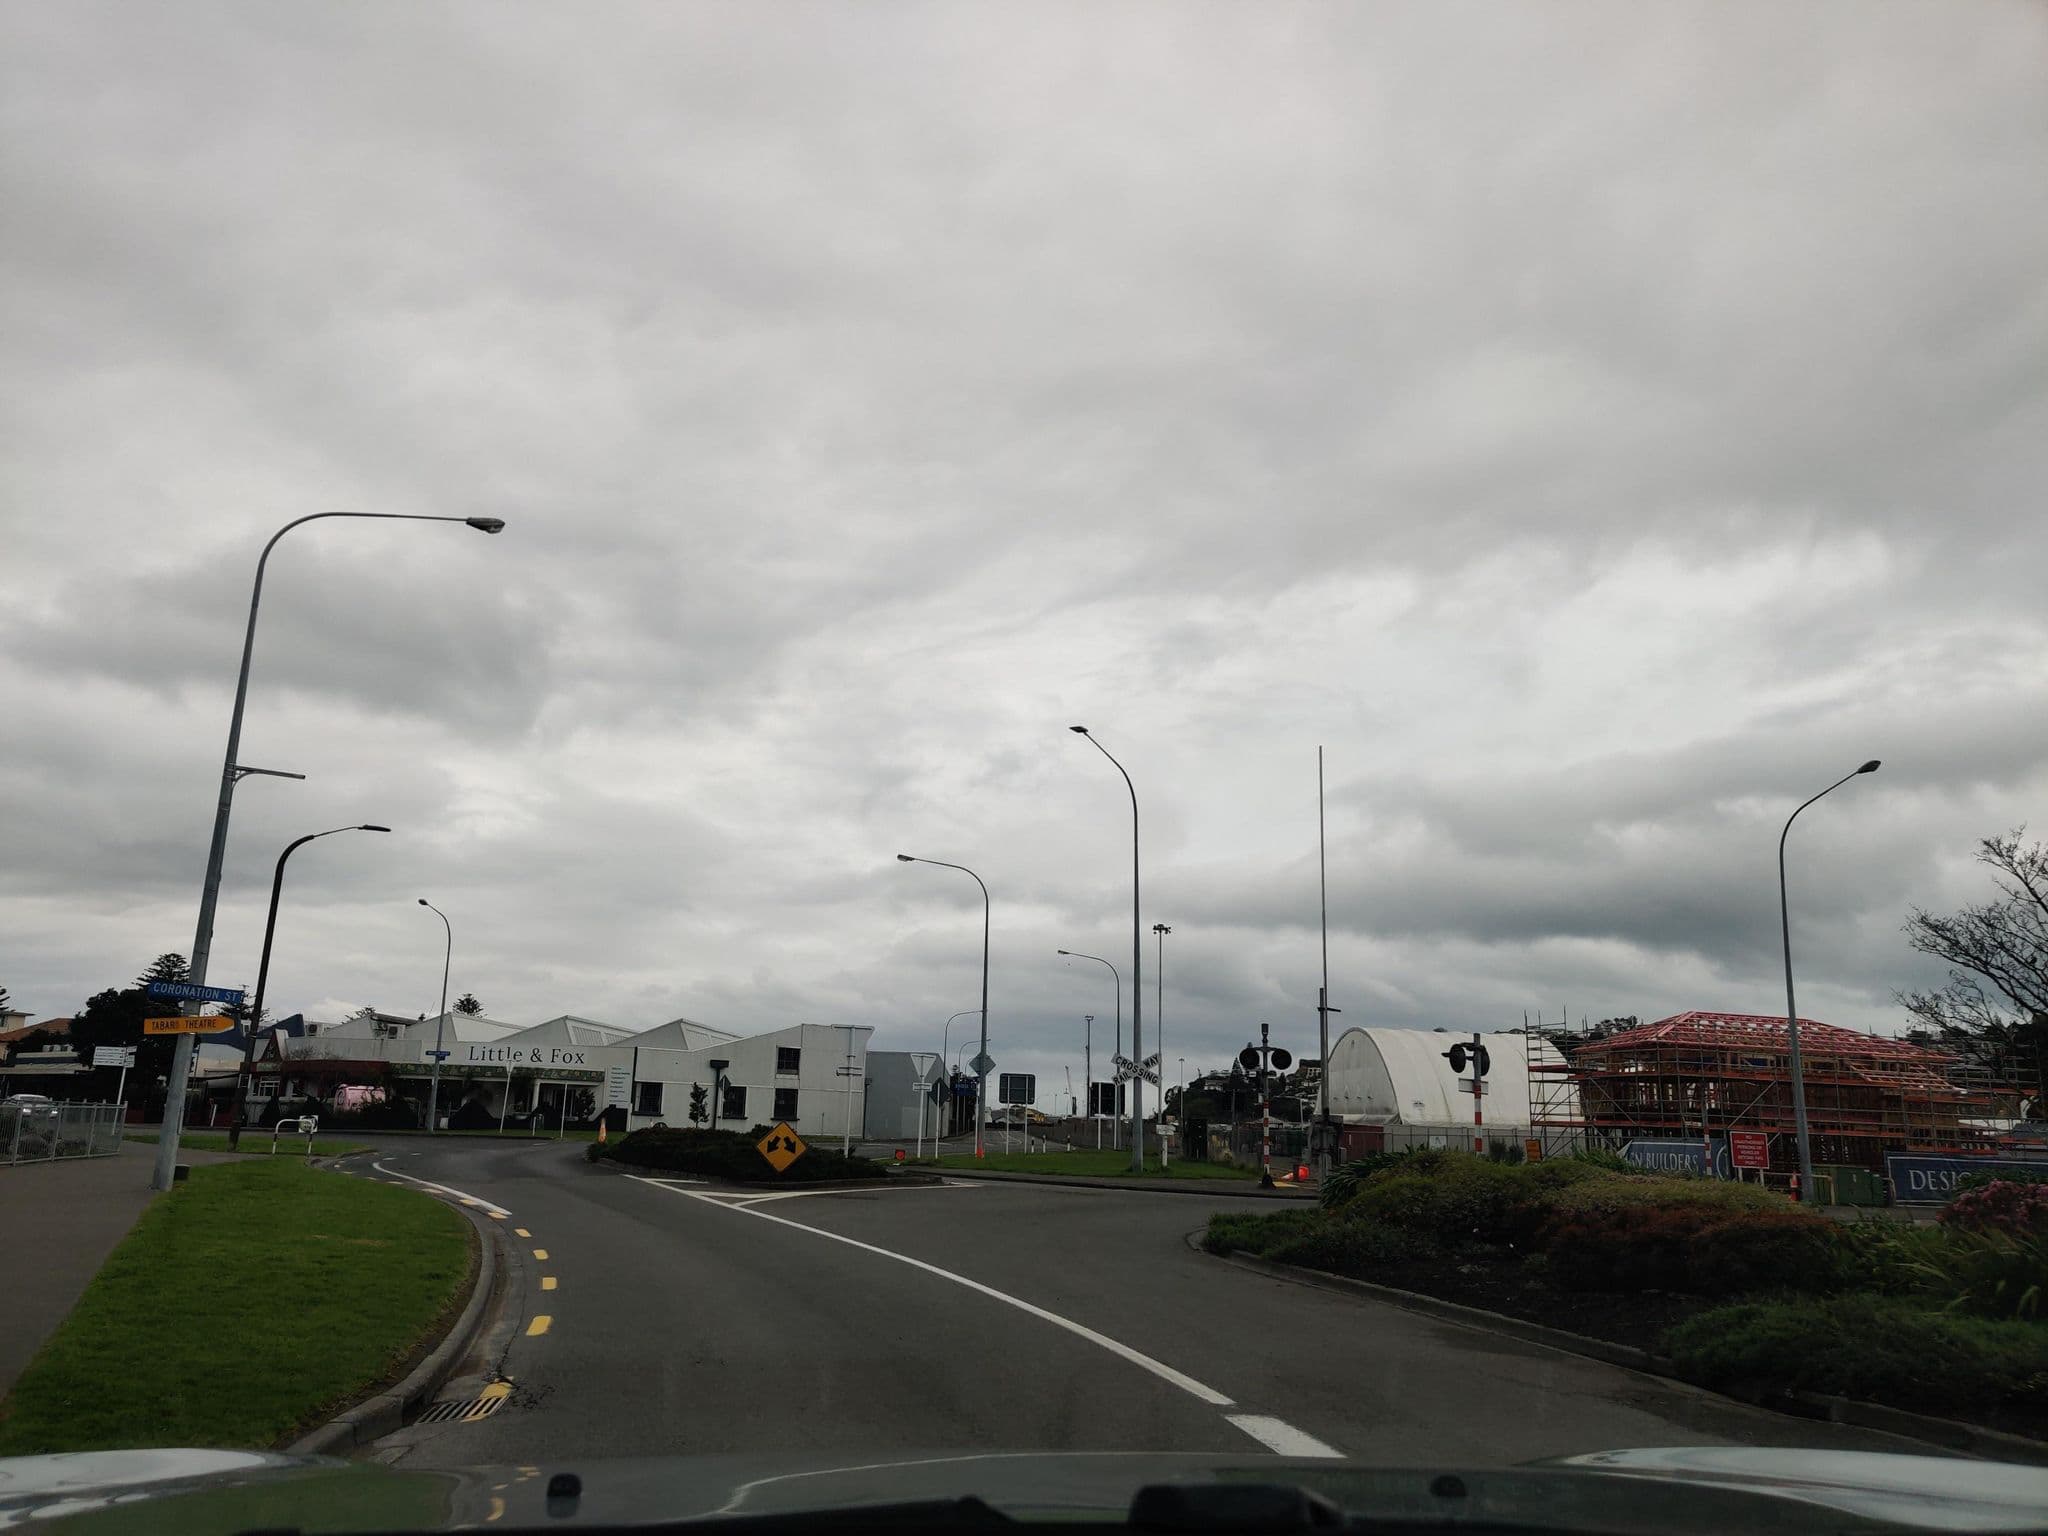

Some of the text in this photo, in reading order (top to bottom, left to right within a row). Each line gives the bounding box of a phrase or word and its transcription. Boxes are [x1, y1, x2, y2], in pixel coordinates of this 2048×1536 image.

[153, 982, 239, 1002] CORONATION ST
[184, 1018, 217, 1030] THEATRE
[469, 1045, 585, 1064] Little & Fox
[1113, 1055, 1159, 1087] RAIL WAY
[1115, 1056, 1159, 1084] CROSSING
[1646, 1152, 1699, 1172] BUILDERS
